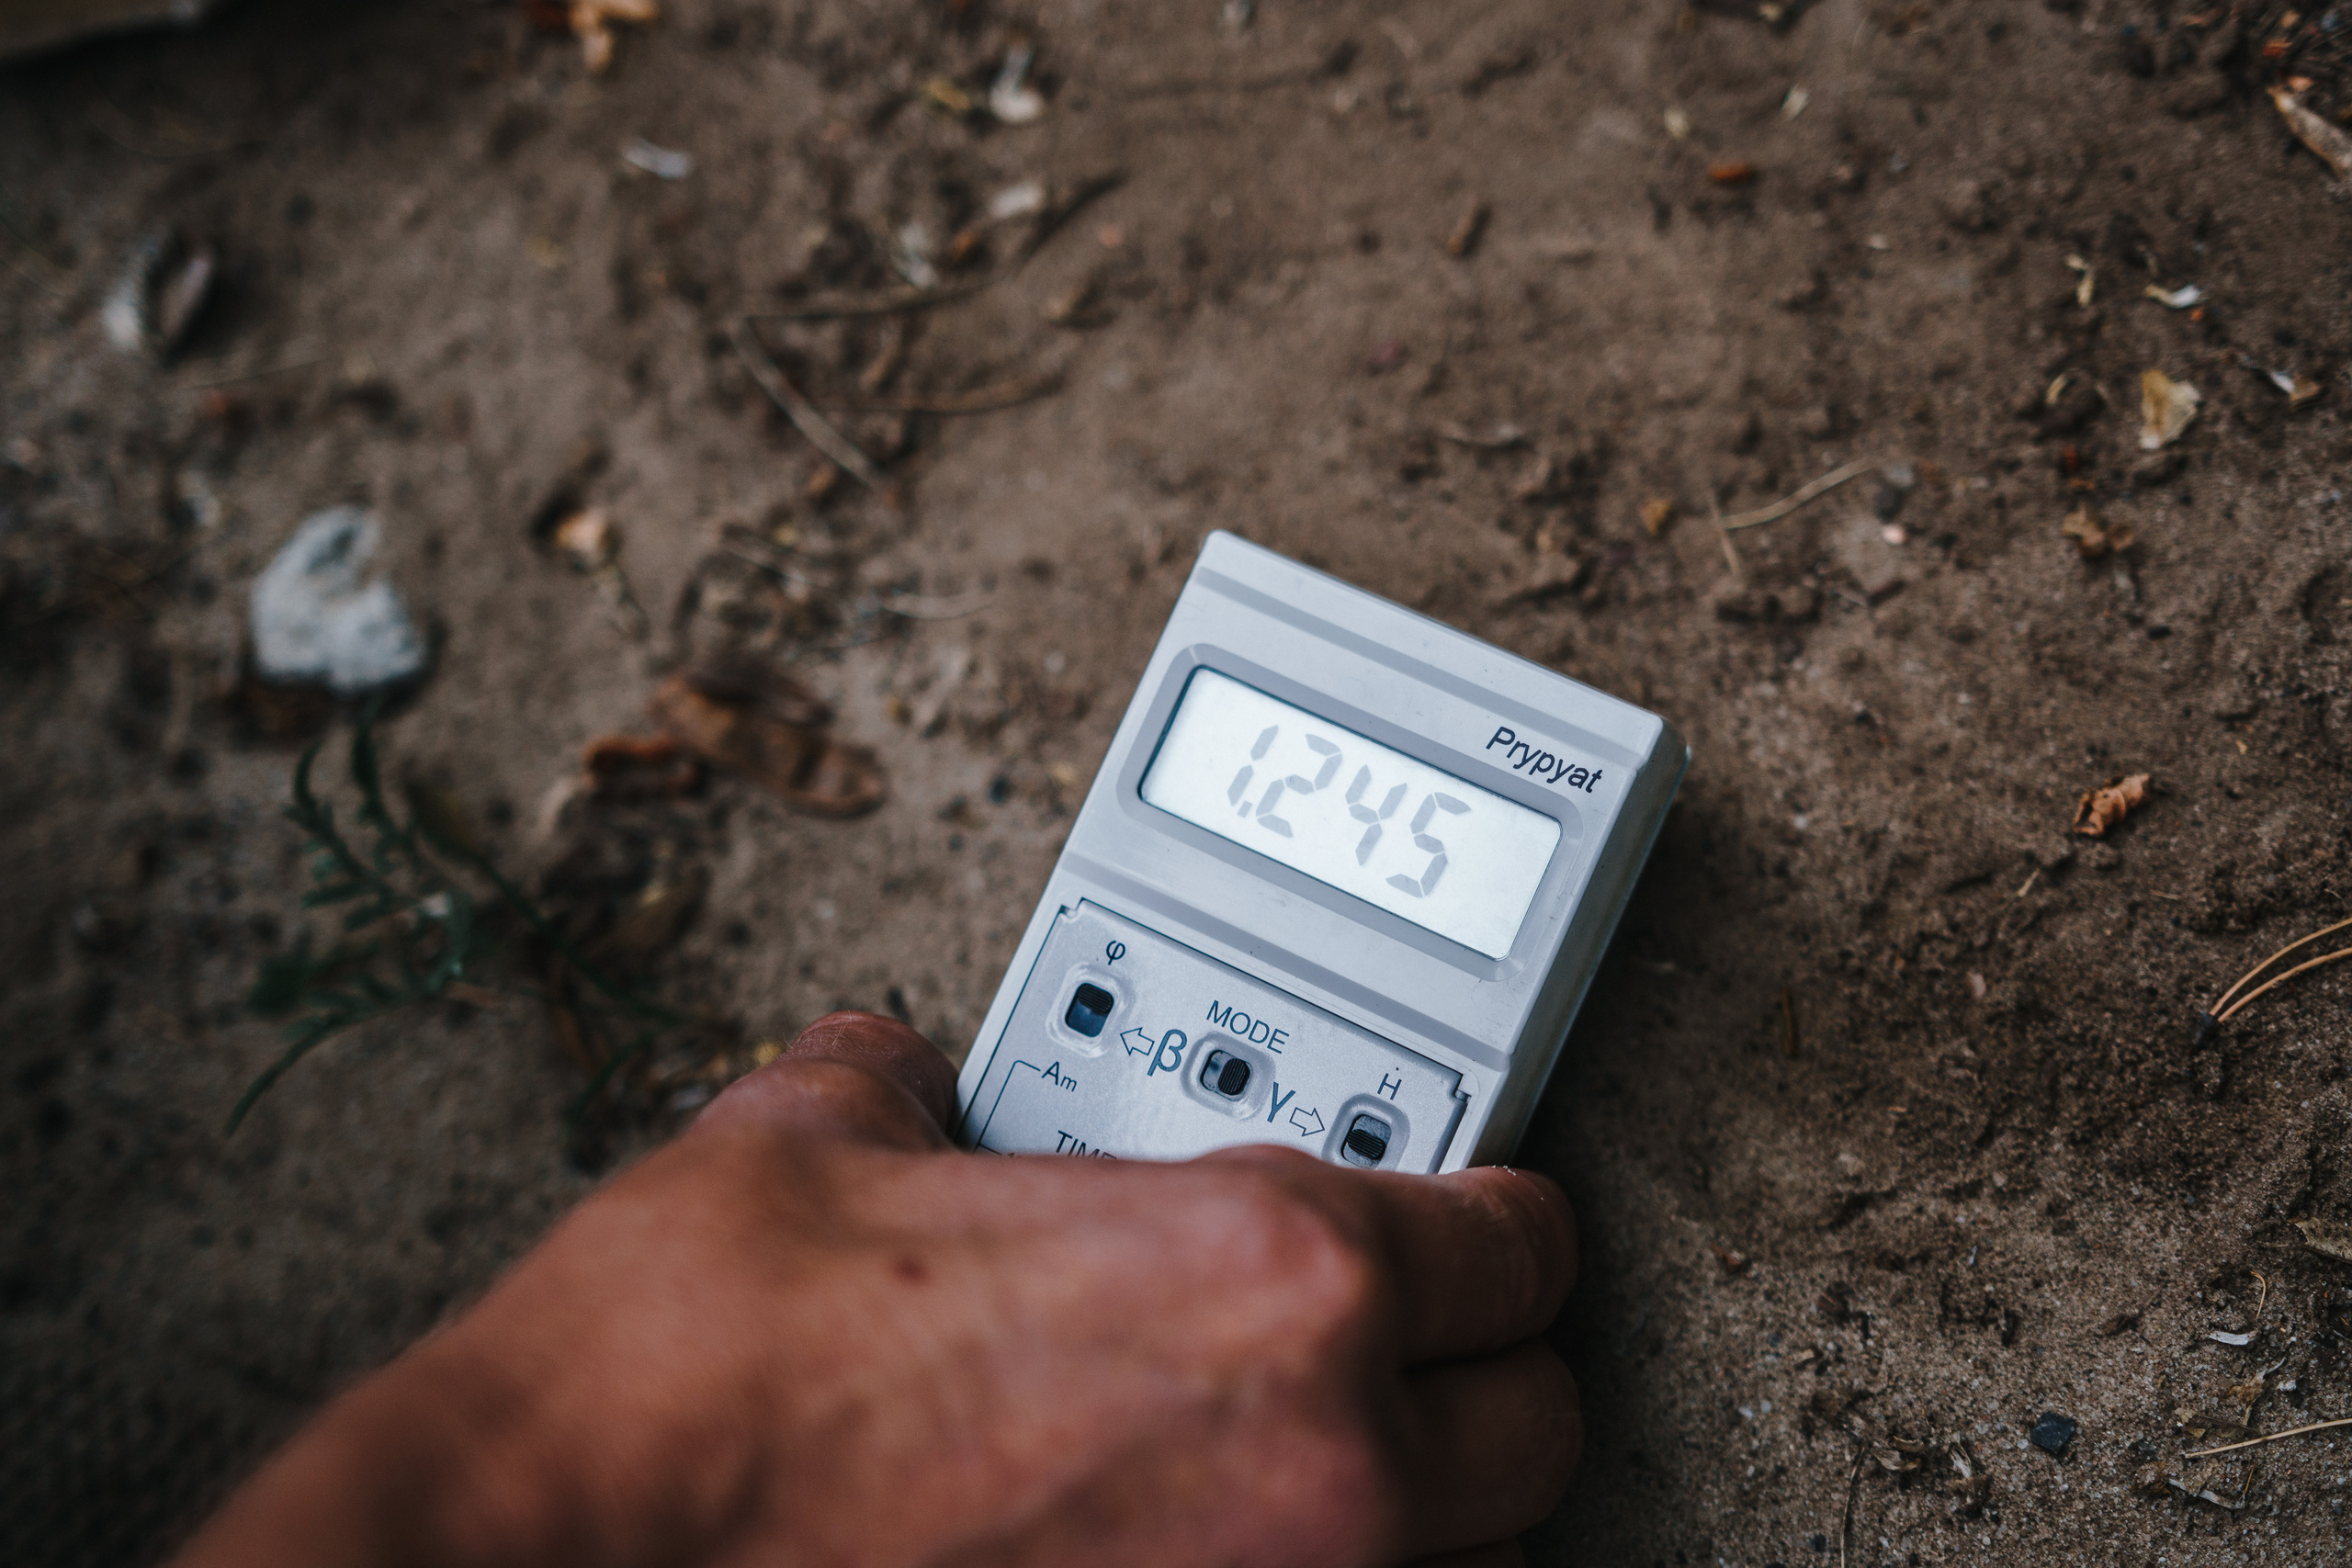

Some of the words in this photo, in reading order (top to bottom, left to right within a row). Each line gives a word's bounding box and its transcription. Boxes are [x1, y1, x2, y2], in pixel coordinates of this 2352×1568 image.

[1486, 726, 1603, 794] Prypyat
[1227, 724, 1472, 899] 1.245
[1205, 999, 1290, 1055] MODE
[1041, 1061, 1078, 1093] Am
